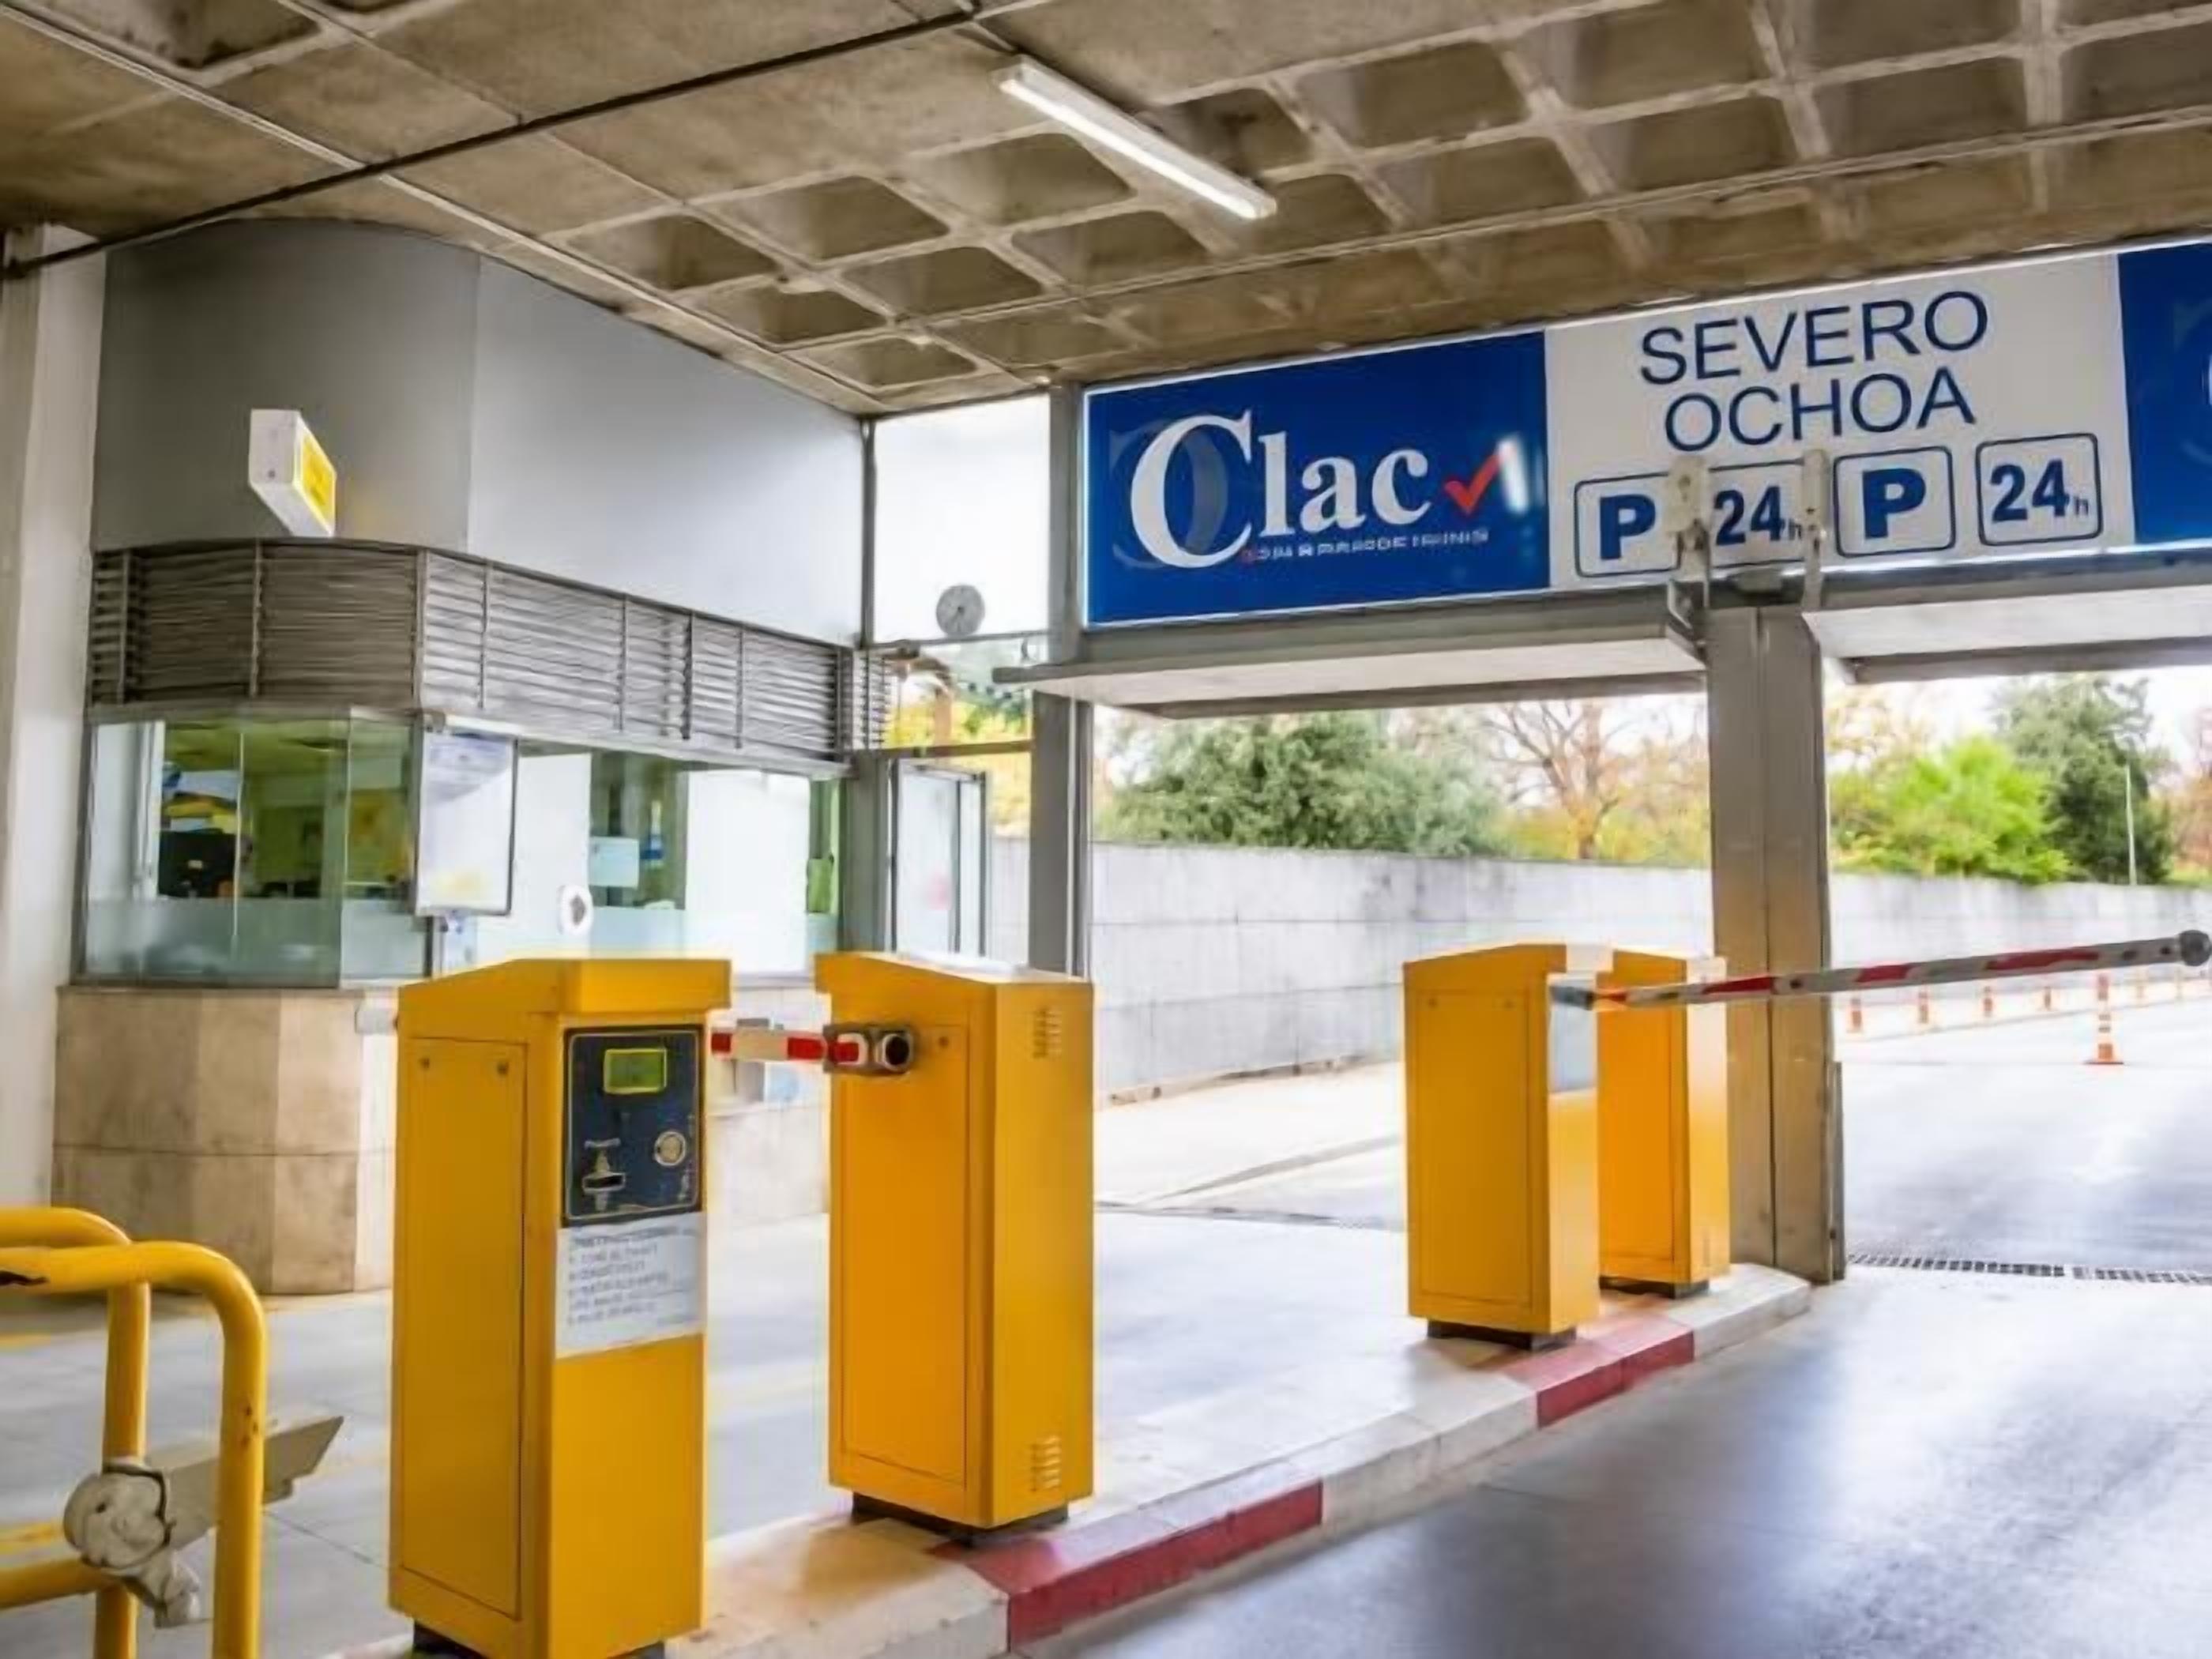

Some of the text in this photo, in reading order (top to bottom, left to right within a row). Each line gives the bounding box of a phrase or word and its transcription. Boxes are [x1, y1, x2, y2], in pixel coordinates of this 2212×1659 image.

[1640, 291, 1988, 386] SEVERO
[1665, 367, 1977, 453] OCHOA
[1130, 410, 1431, 569] Clac
[1599, 494, 1656, 561] P
[1862, 468, 1927, 540] P
